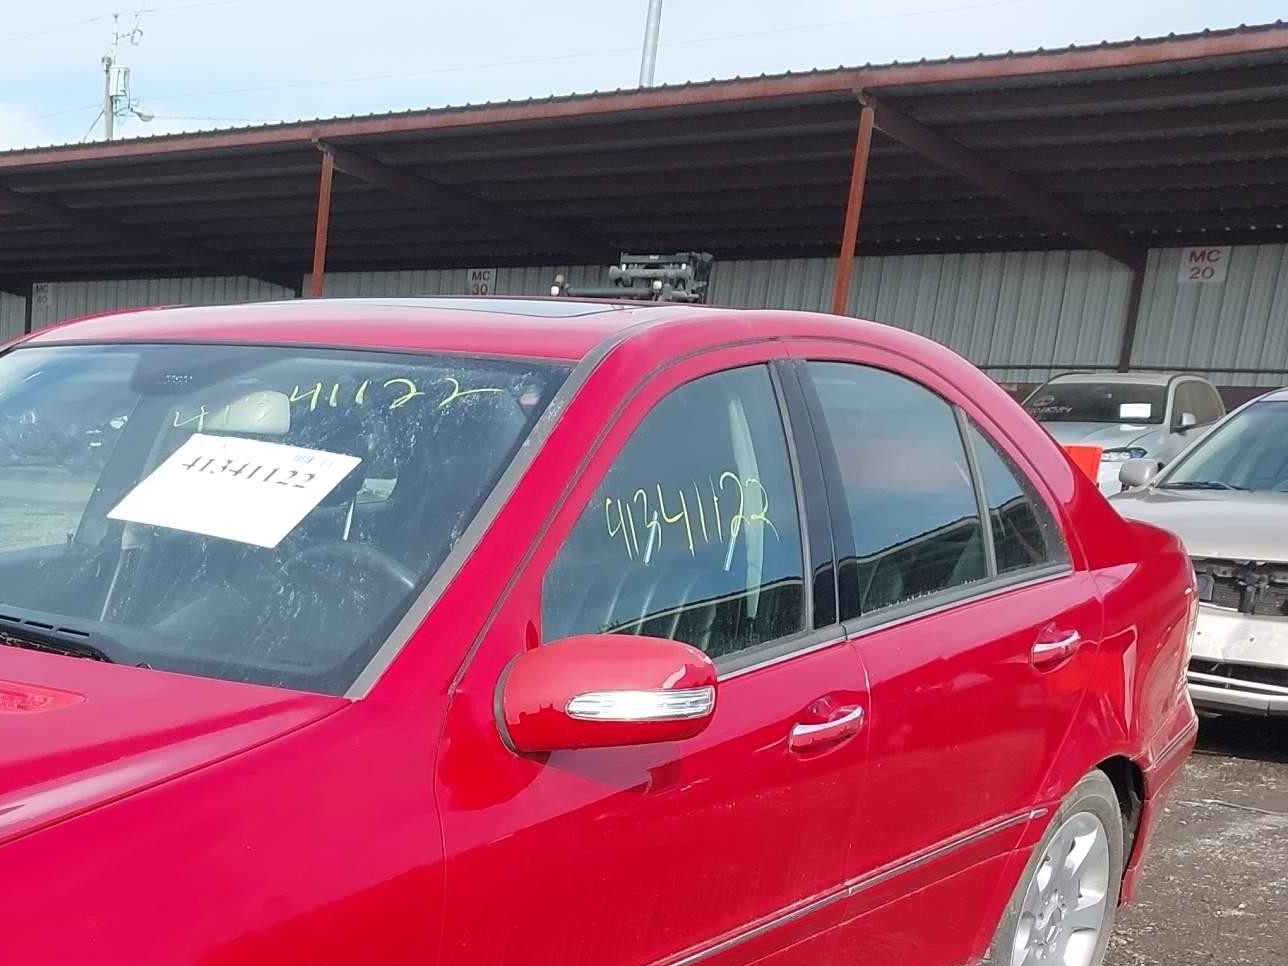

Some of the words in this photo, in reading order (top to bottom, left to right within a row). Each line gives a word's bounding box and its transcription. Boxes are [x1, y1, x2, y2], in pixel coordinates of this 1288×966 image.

[1190, 249, 1221, 263] MC
[472, 271, 490, 281] MC
[1190, 267, 1215, 280] 20
[472, 284, 488, 295] 30
[182, 456, 316, 489] 41341122
[606, 471, 780, 560] 41341122
